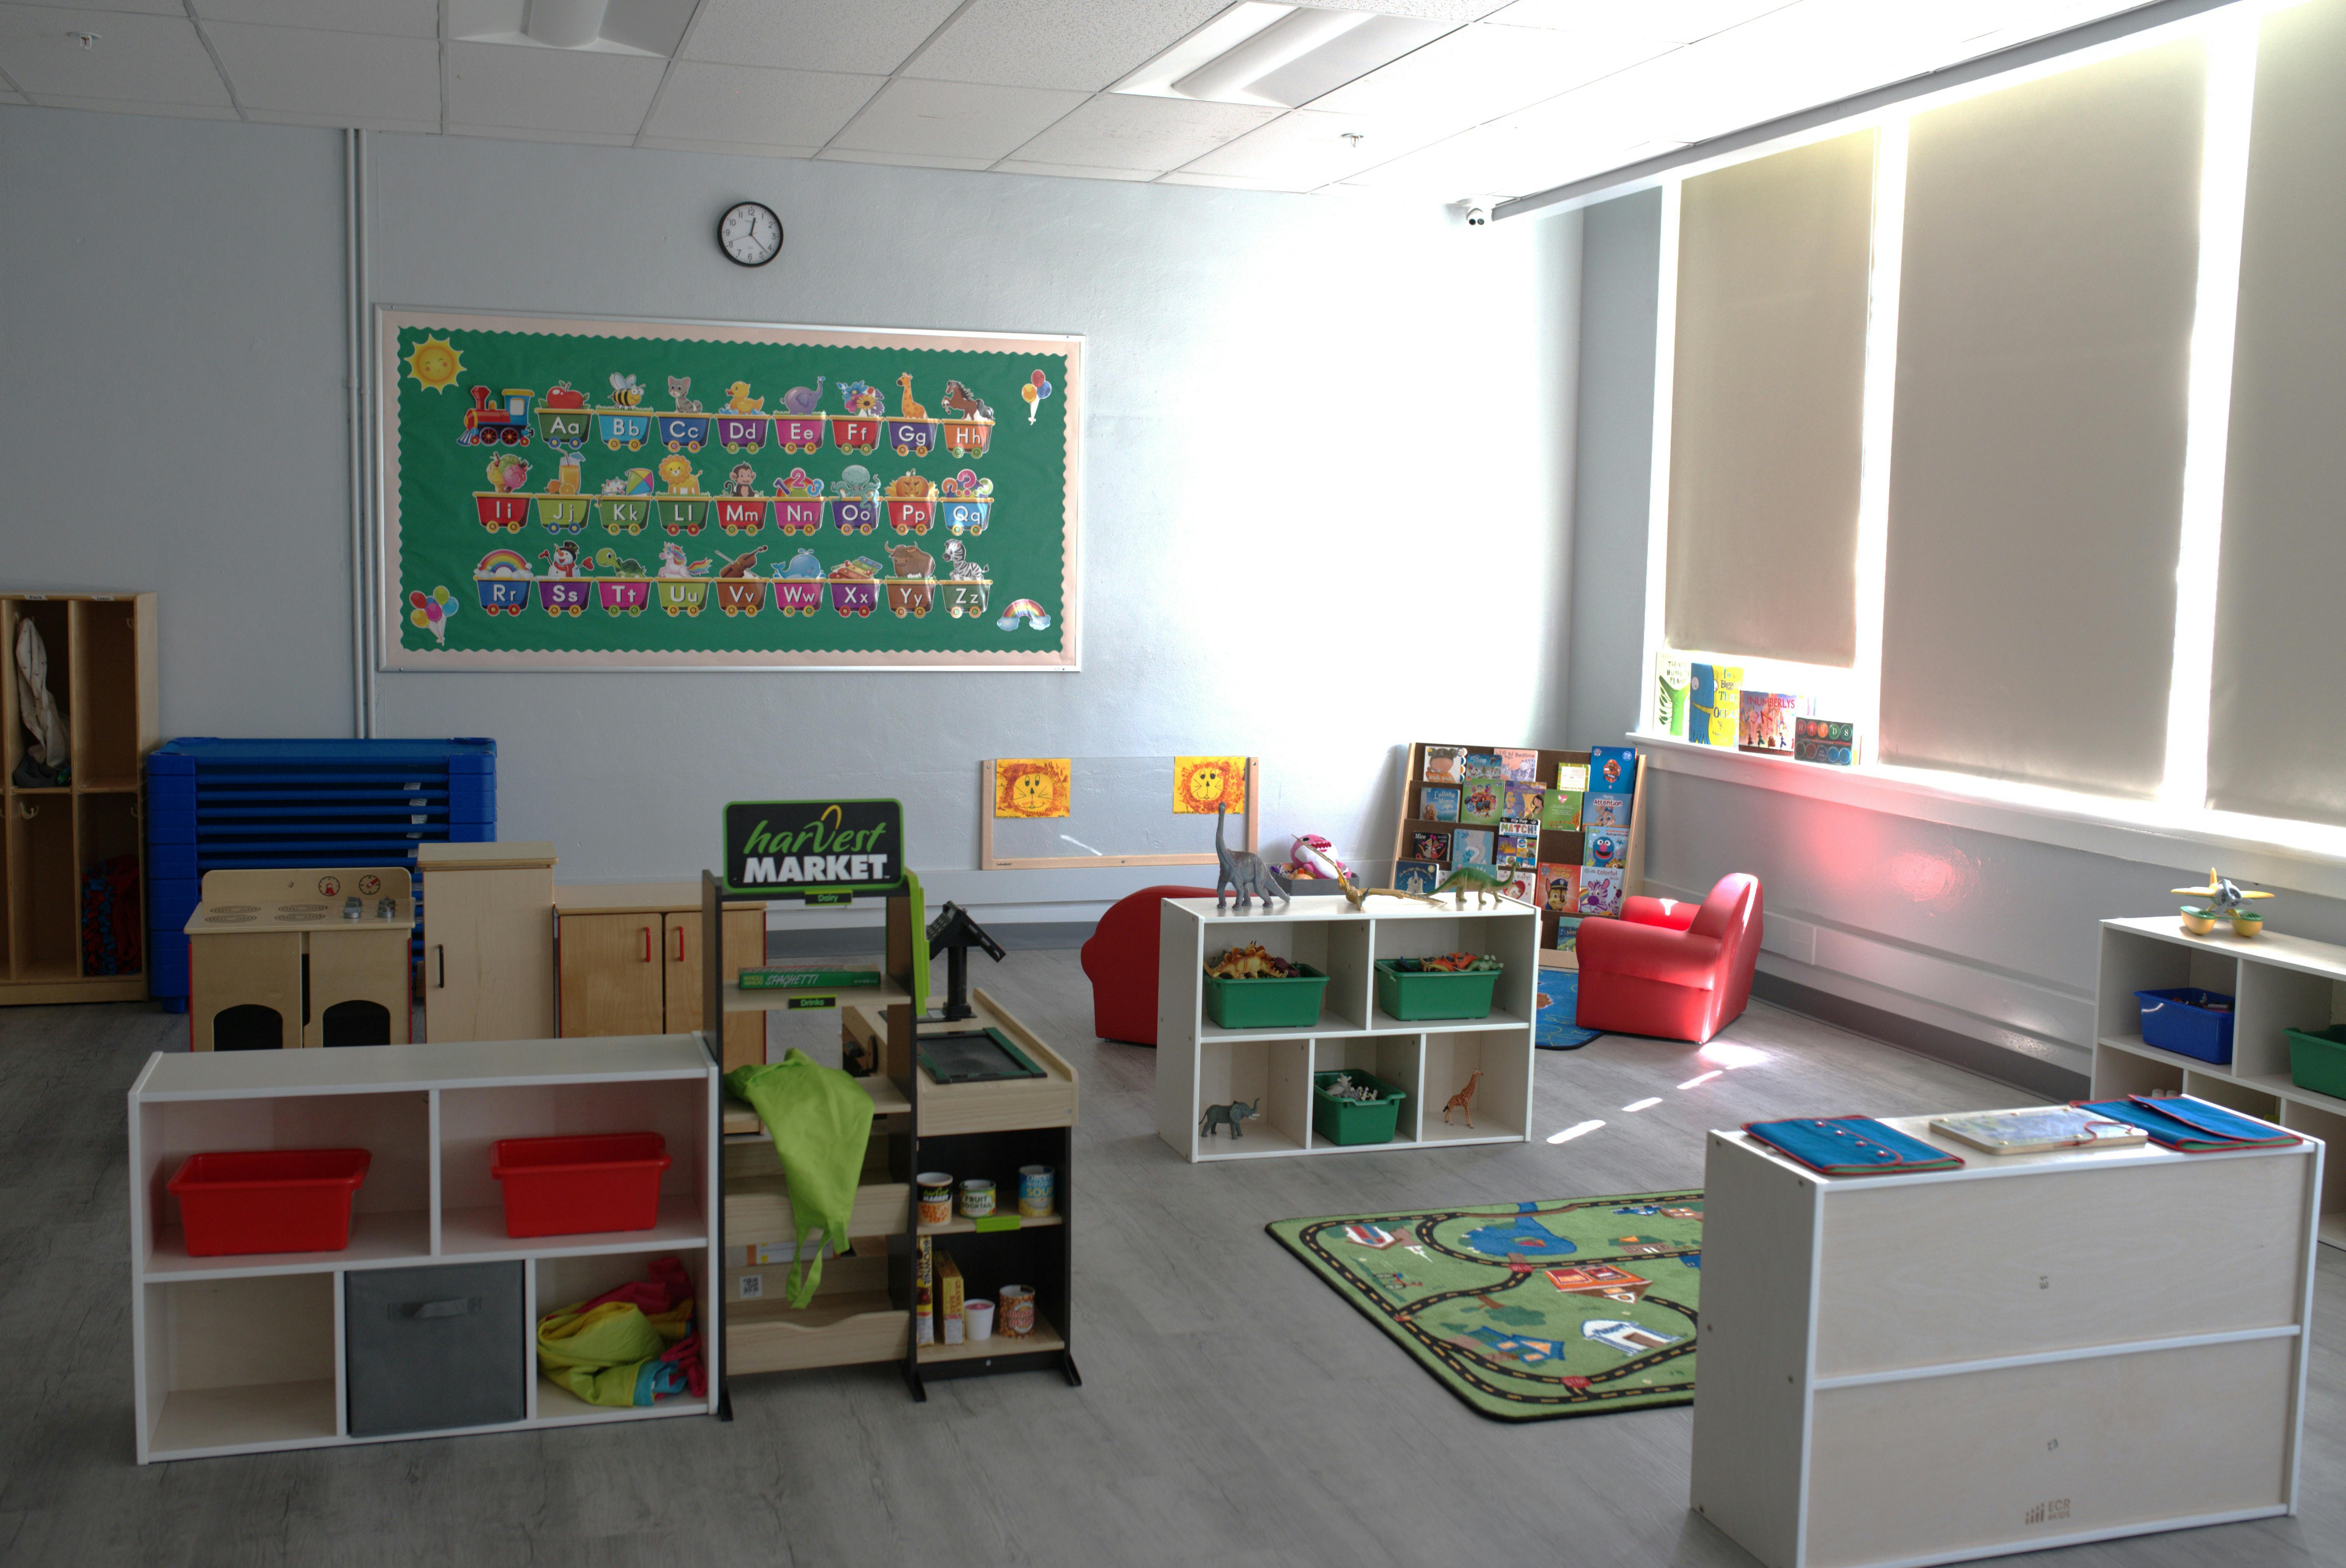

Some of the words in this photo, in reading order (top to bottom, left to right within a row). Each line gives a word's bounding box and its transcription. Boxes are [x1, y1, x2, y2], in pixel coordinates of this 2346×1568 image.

[550, 416, 579, 434] Aa
[613, 418, 639, 436] Bb
[669, 420, 698, 438] Cc
[730, 422, 756, 439] Dd
[791, 423, 813, 439] Ee
[848, 424, 867, 440] Ff
[898, 425, 926, 445] Gg
[957, 428, 980, 444] Hh
[774, 478, 790, 495] 1
[790, 469, 806, 488] 2
[808, 480, 823, 496] 3
[496, 501, 511, 518] Ii
[553, 503, 573, 522] Jj
[614, 504, 637, 520] Kk
[675, 504, 692, 521] Ll
[727, 505, 758, 521] Mm
[787, 505, 812, 522] Nn
[842, 506, 870, 521] Oo
[903, 505, 925, 523] Pp
[953, 506, 980, 524] Qq
[494, 584, 516, 601] Rr
[553, 584, 578, 602] Ss
[612, 585, 636, 602] Tt
[671, 586, 697, 602] Uu
[729, 586, 754, 602] Vv
[784, 586, 815, 602] Ww
[844, 587, 868, 603] Xx
[900, 588, 923, 607] Yy
[956, 588, 978, 604] Zz
[1750, 696, 1795, 709] NUMBERLYS
[1434, 791, 1455, 800] Lullaby
[743, 805, 886, 854] harvest
[1500, 823, 1537, 834] MATCH!
[743, 854, 887, 883] MARKET
[818, 894, 838, 903] Dairy
[765, 974, 819, 987] SPAGHETTI
[800, 999, 825, 1007] Drinks
